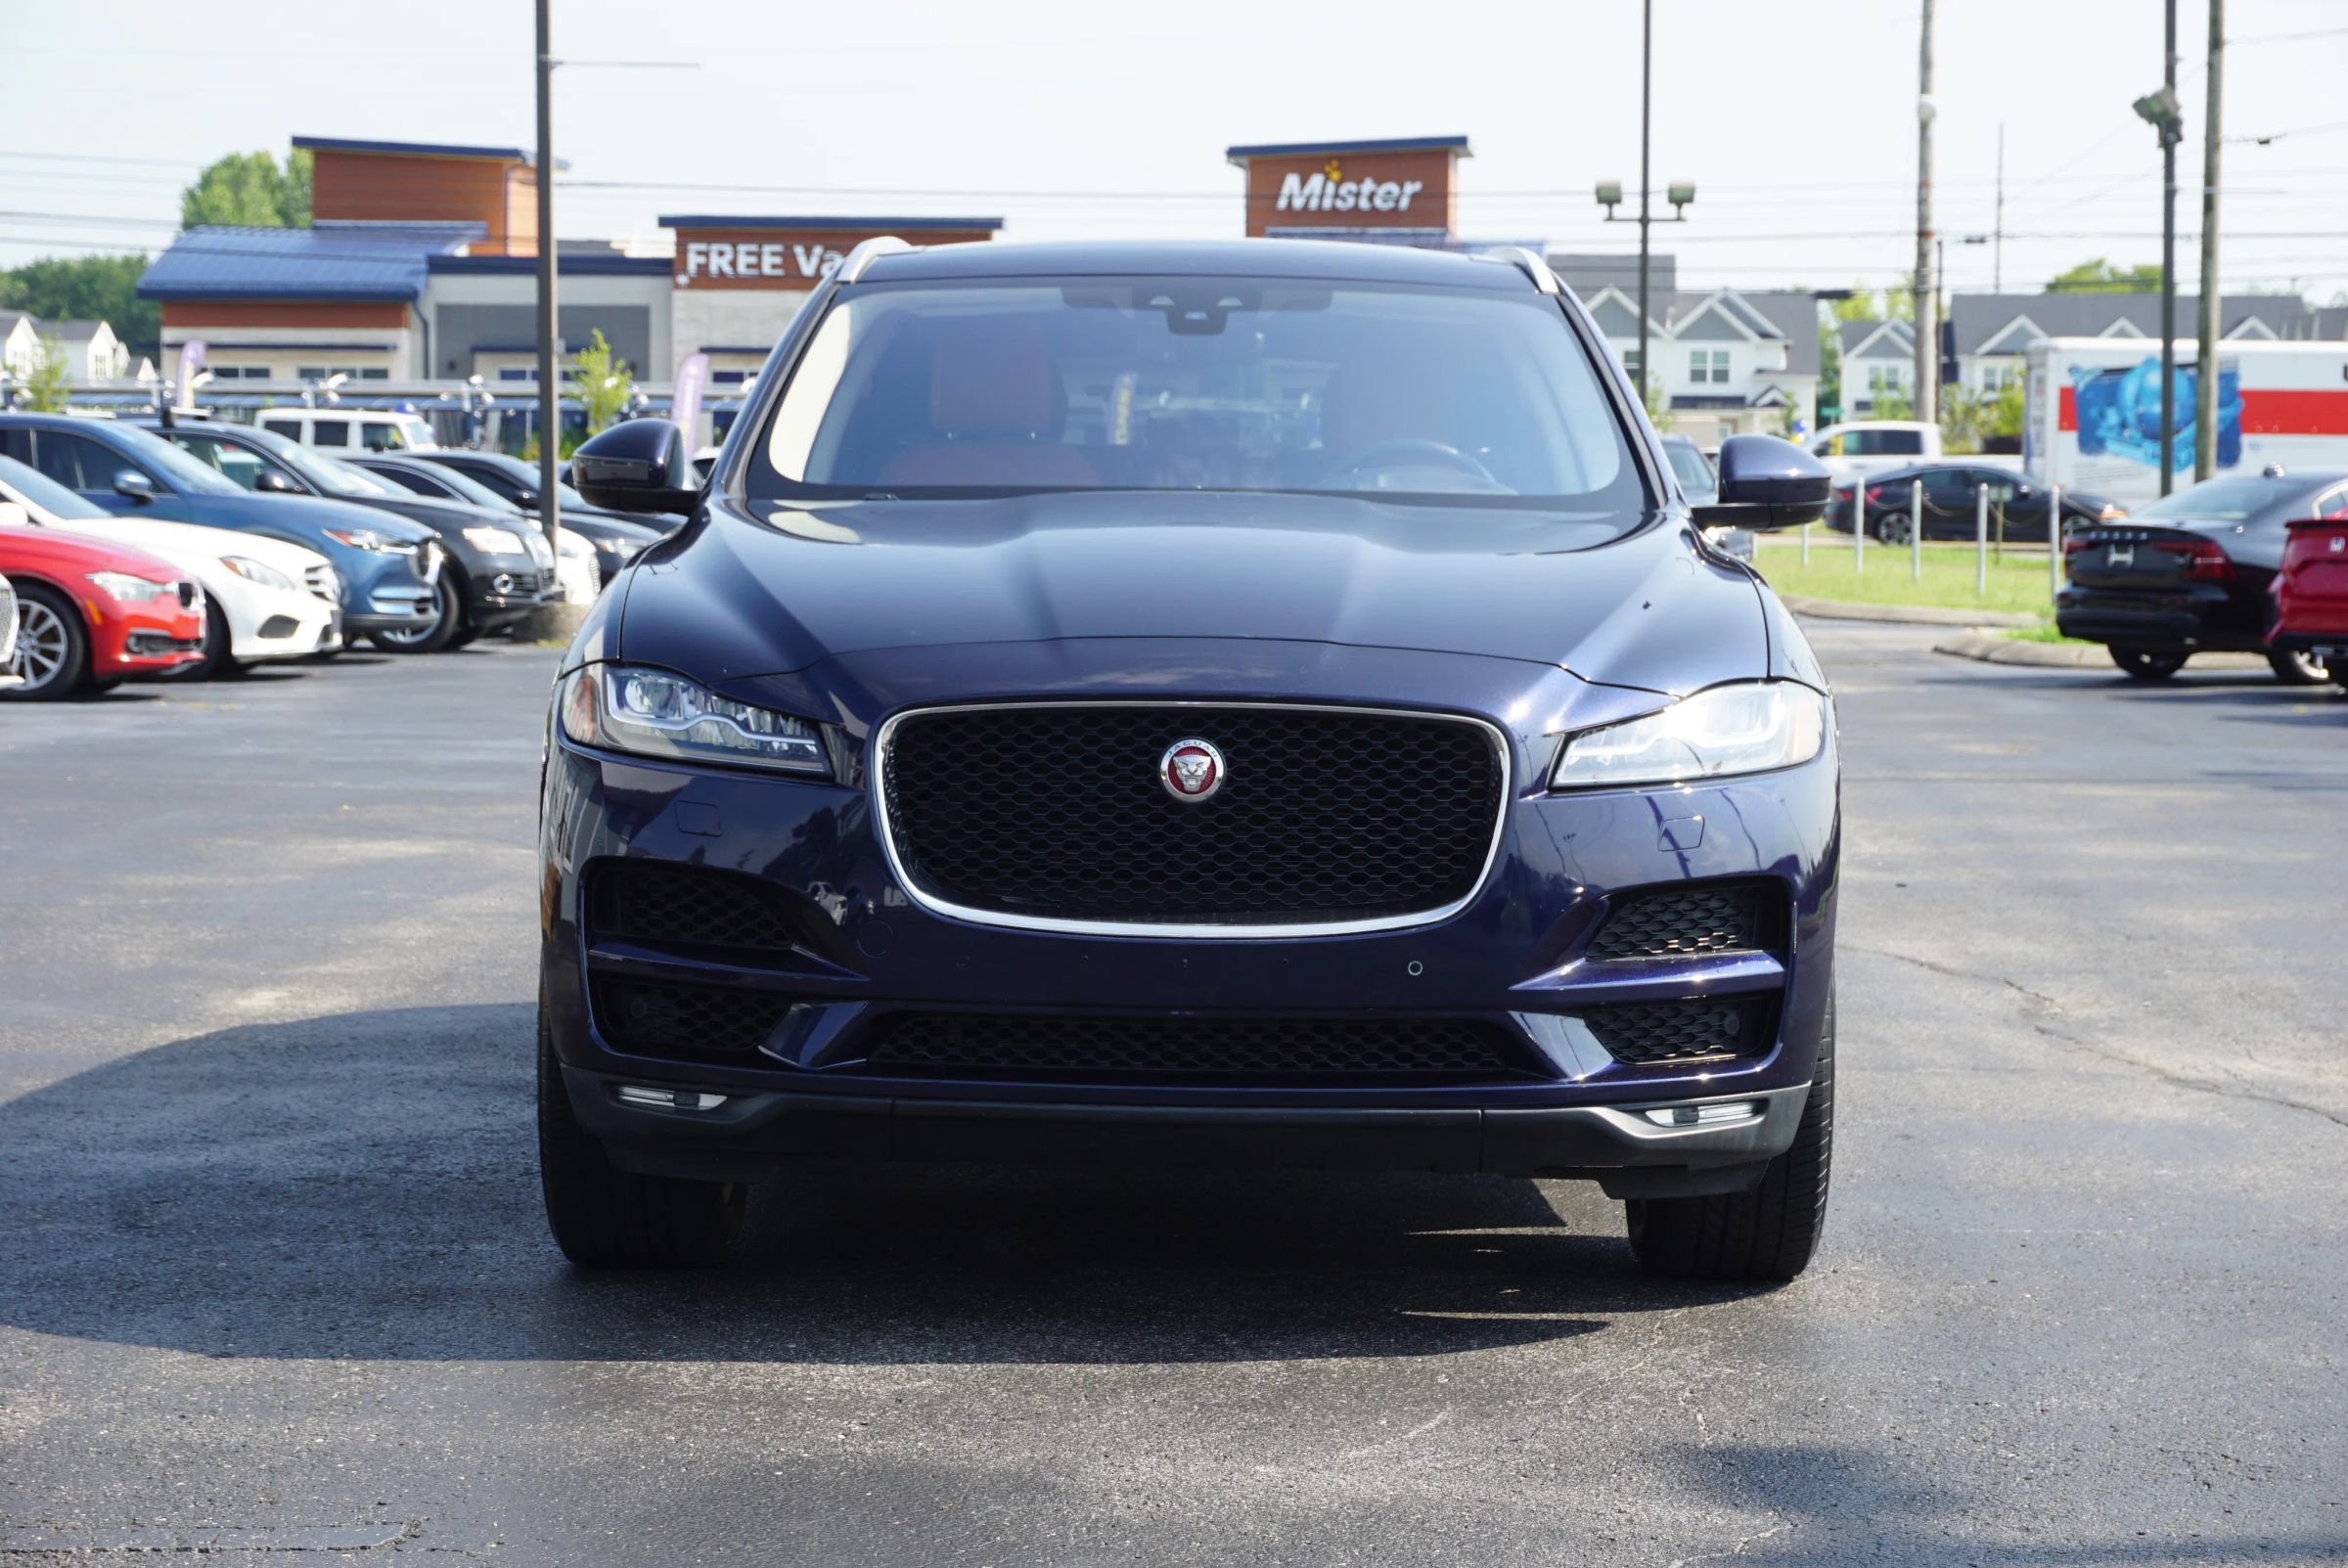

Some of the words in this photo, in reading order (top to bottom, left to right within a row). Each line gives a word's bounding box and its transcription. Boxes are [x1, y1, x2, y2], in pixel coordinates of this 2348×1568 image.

[1276, 160, 1423, 211] Mister
[687, 243, 786, 277] FREE
[1167, 739, 1219, 759] JAGUAR
